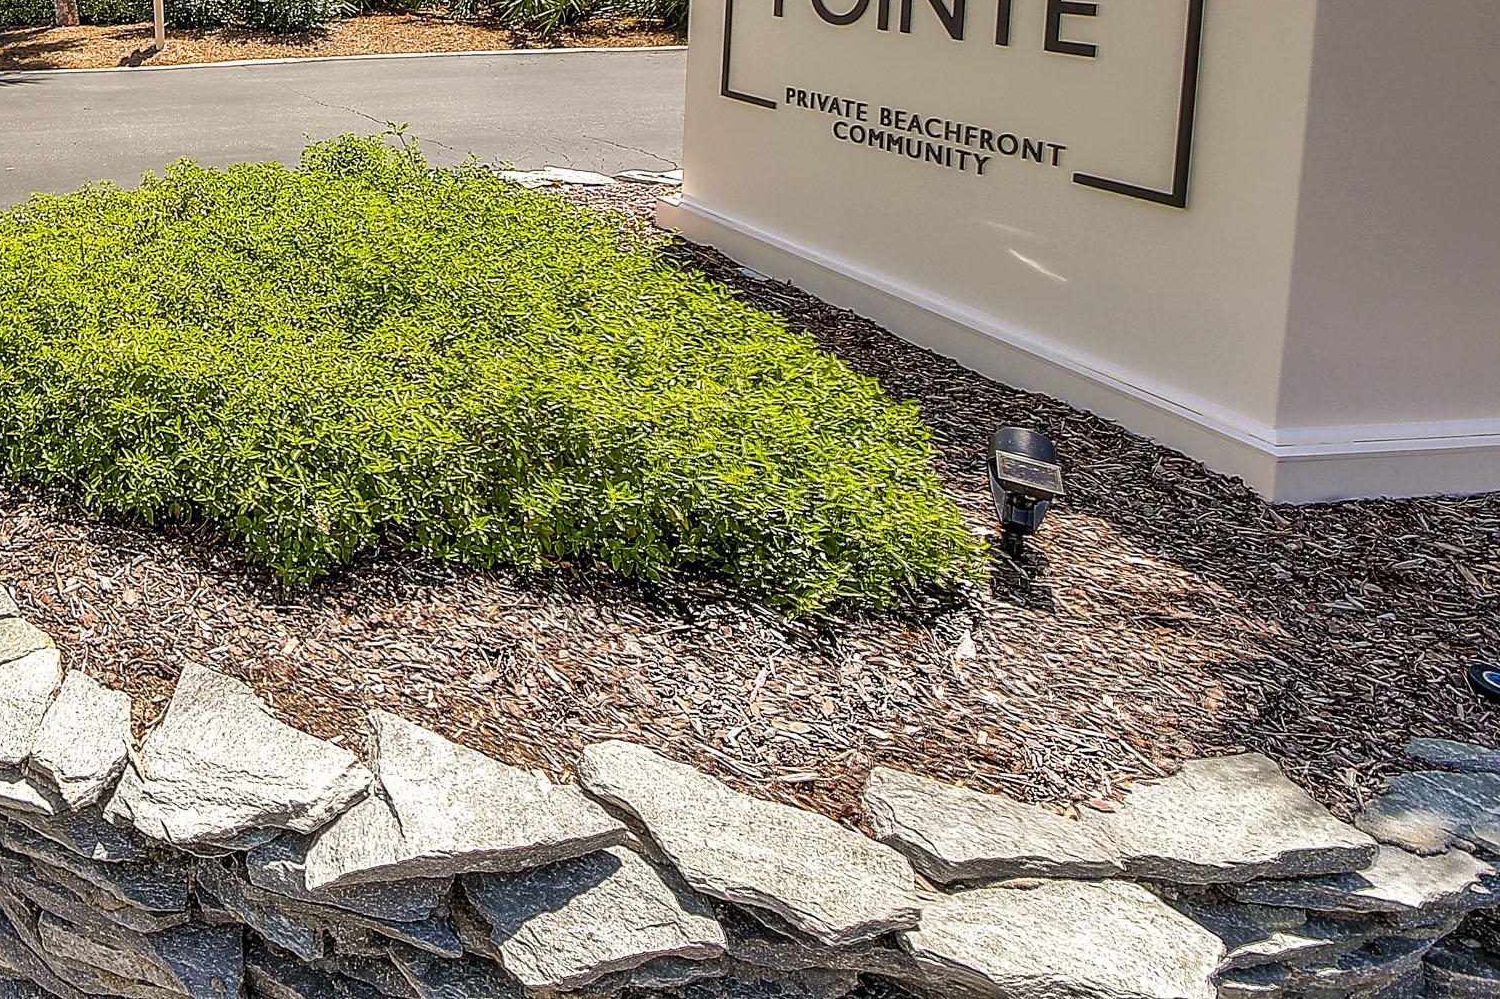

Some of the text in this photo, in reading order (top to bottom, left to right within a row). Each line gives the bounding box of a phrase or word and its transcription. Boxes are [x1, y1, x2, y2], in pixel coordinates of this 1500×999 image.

[786, 86, 1068, 167] PRIVATE BEACHFRONT
[832, 120, 992, 176] COMMUNITY
